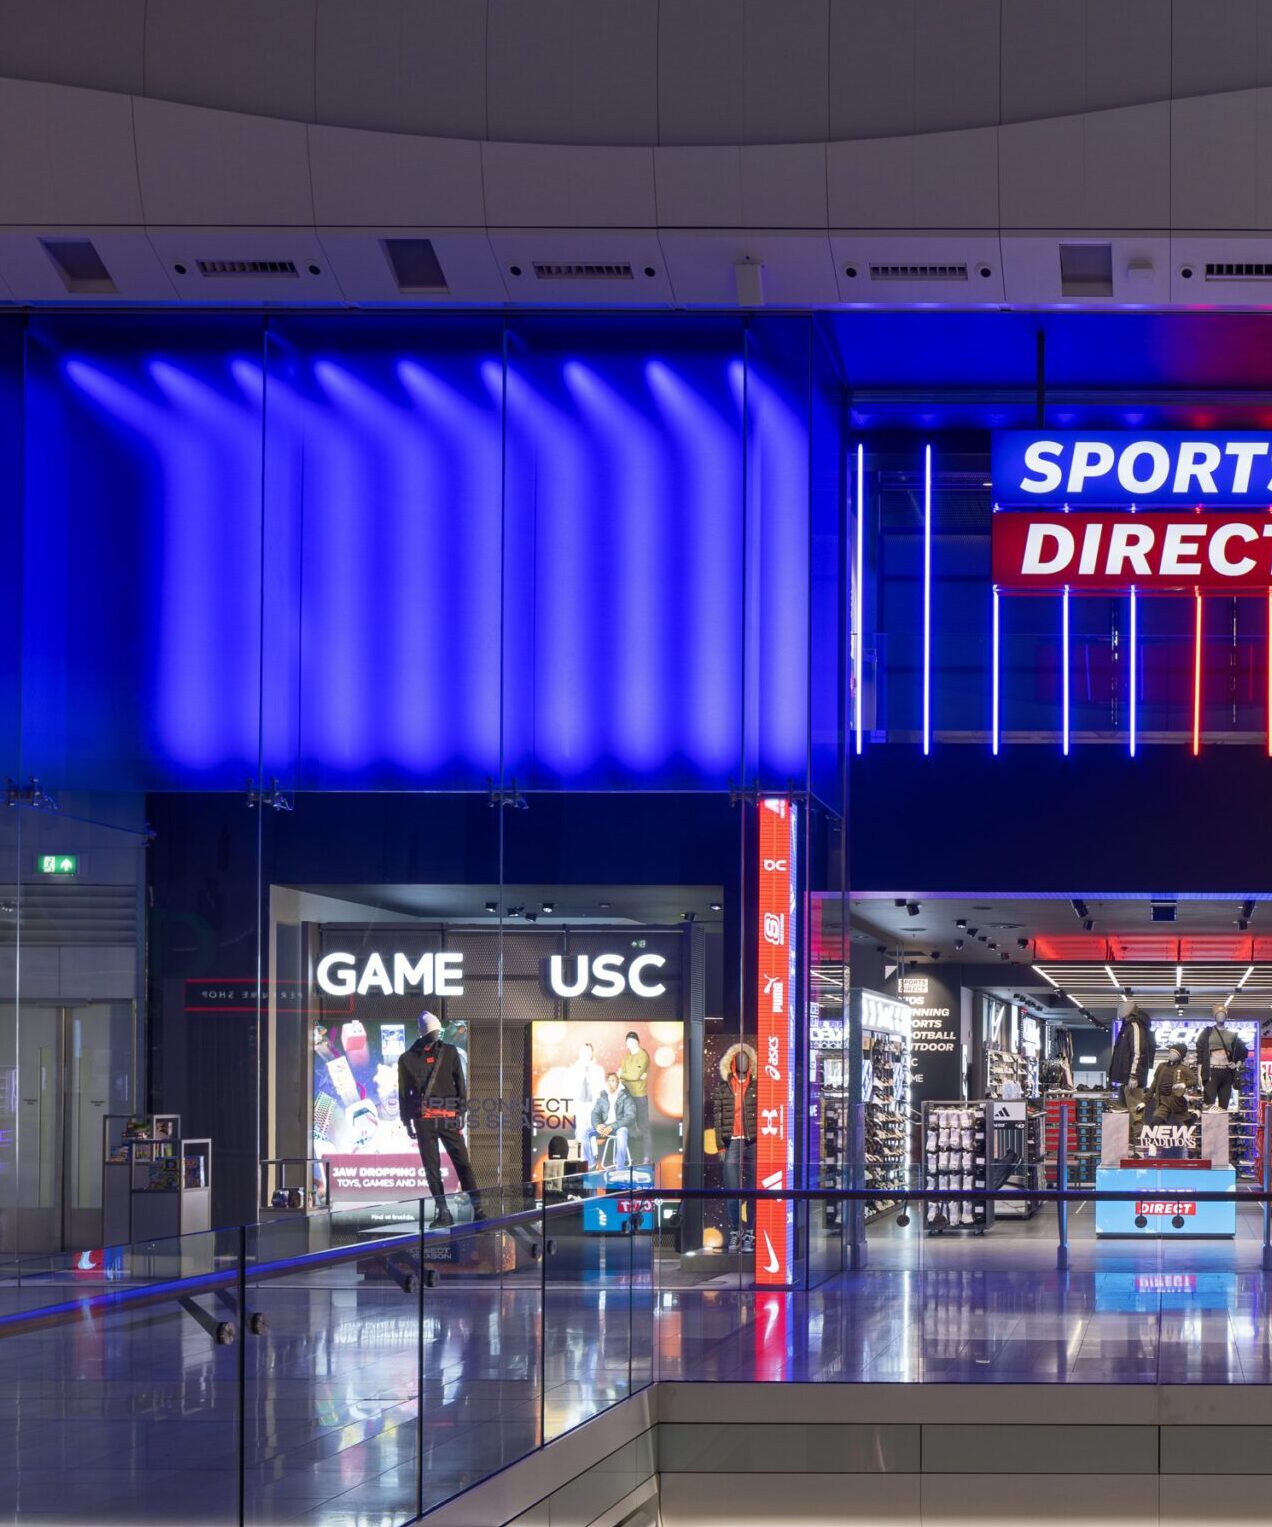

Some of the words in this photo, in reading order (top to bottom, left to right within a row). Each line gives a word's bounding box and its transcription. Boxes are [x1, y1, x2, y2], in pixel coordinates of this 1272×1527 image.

[316, 952, 464, 996] GAME
[550, 954, 667, 998] USC
[912, 1008, 950, 1017] NNING
[911, 1020, 942, 1028] ORTS
[911, 1031, 956, 1040] OTBALL
[768, 1036, 780, 1066] asics
[910, 1043, 954, 1051] TDOOR
[1140, 1125, 1197, 1139] NEW
[1138, 1137, 1197, 1149] TRADITIONS
[332, 1167, 358, 1177] JAW
[359, 1167, 416, 1177] DROPPING
[337, 1179, 362, 1189] TOYS,
[363, 1179, 395, 1188] GAMES
[396, 1179, 416, 1188] AND
[1140, 1203, 1192, 1214] DIRECT
